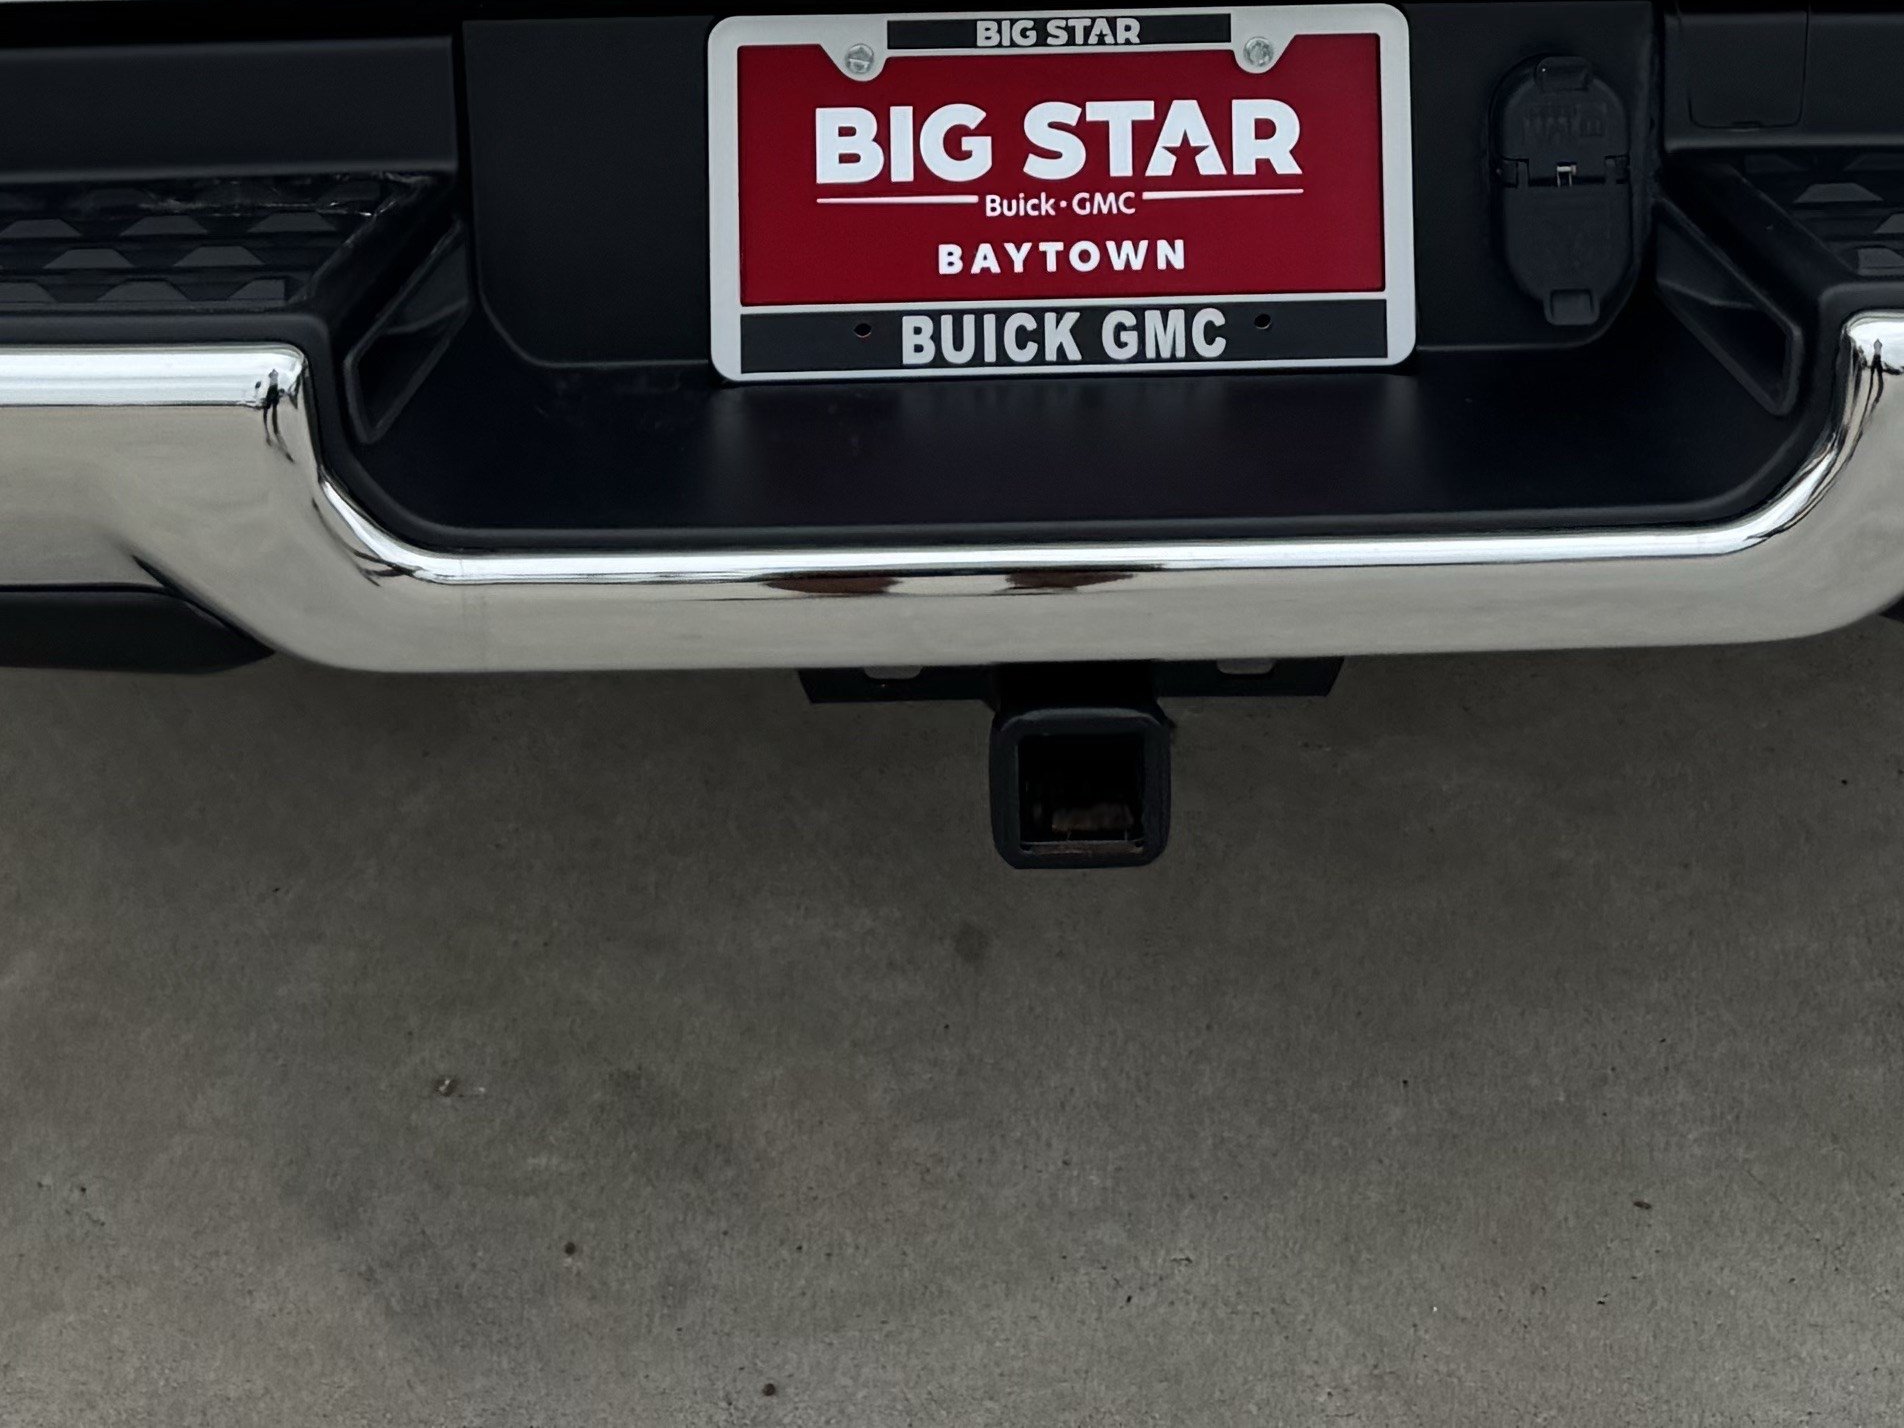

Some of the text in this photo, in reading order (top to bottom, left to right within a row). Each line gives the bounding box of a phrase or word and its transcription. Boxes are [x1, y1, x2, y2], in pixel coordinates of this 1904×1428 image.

[976, 17, 1141, 48] BIG STAR
[815, 99, 1303, 185] BIG STAR
[938, 240, 1185, 275] BAYTOWN
[901, 308, 1228, 365] BUICK GMC
